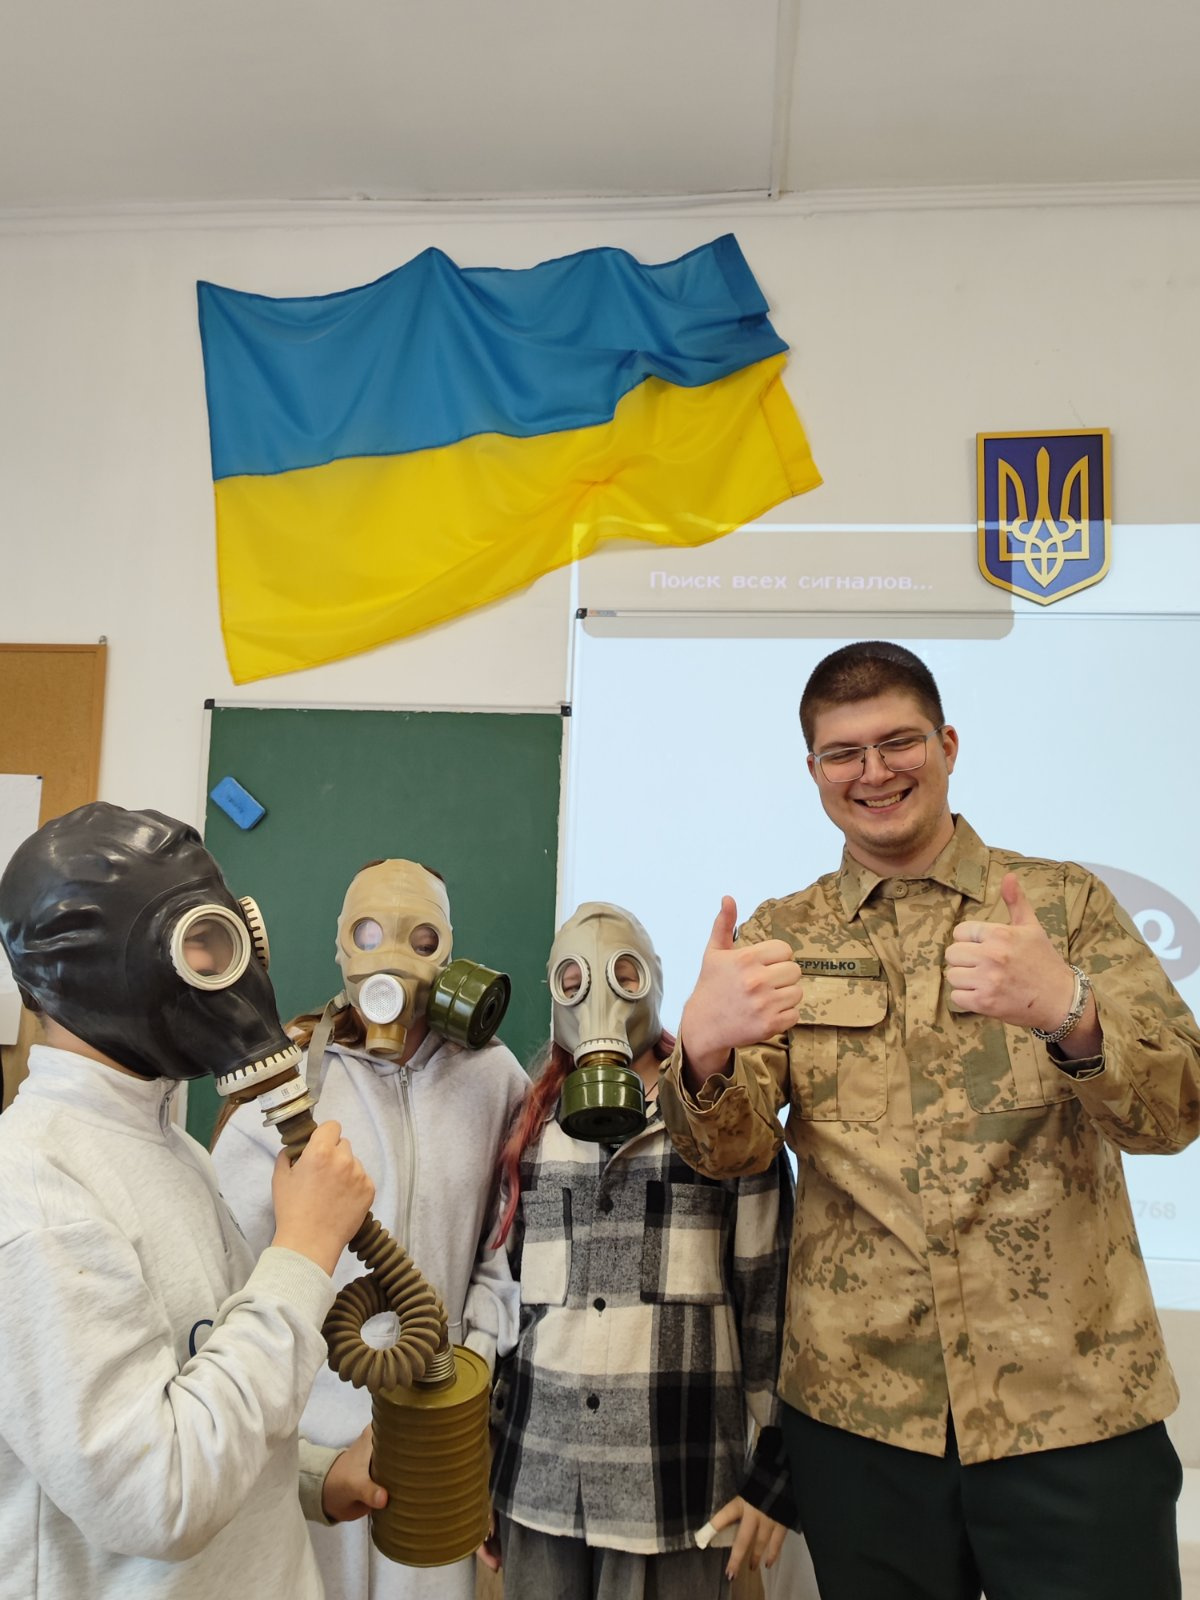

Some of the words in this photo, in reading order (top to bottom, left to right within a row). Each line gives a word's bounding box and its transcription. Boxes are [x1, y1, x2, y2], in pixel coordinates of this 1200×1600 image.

[650, 570, 721, 589] Поиск
[732, 575, 788, 589] всех
[798, 575, 933, 590] сигналов...
